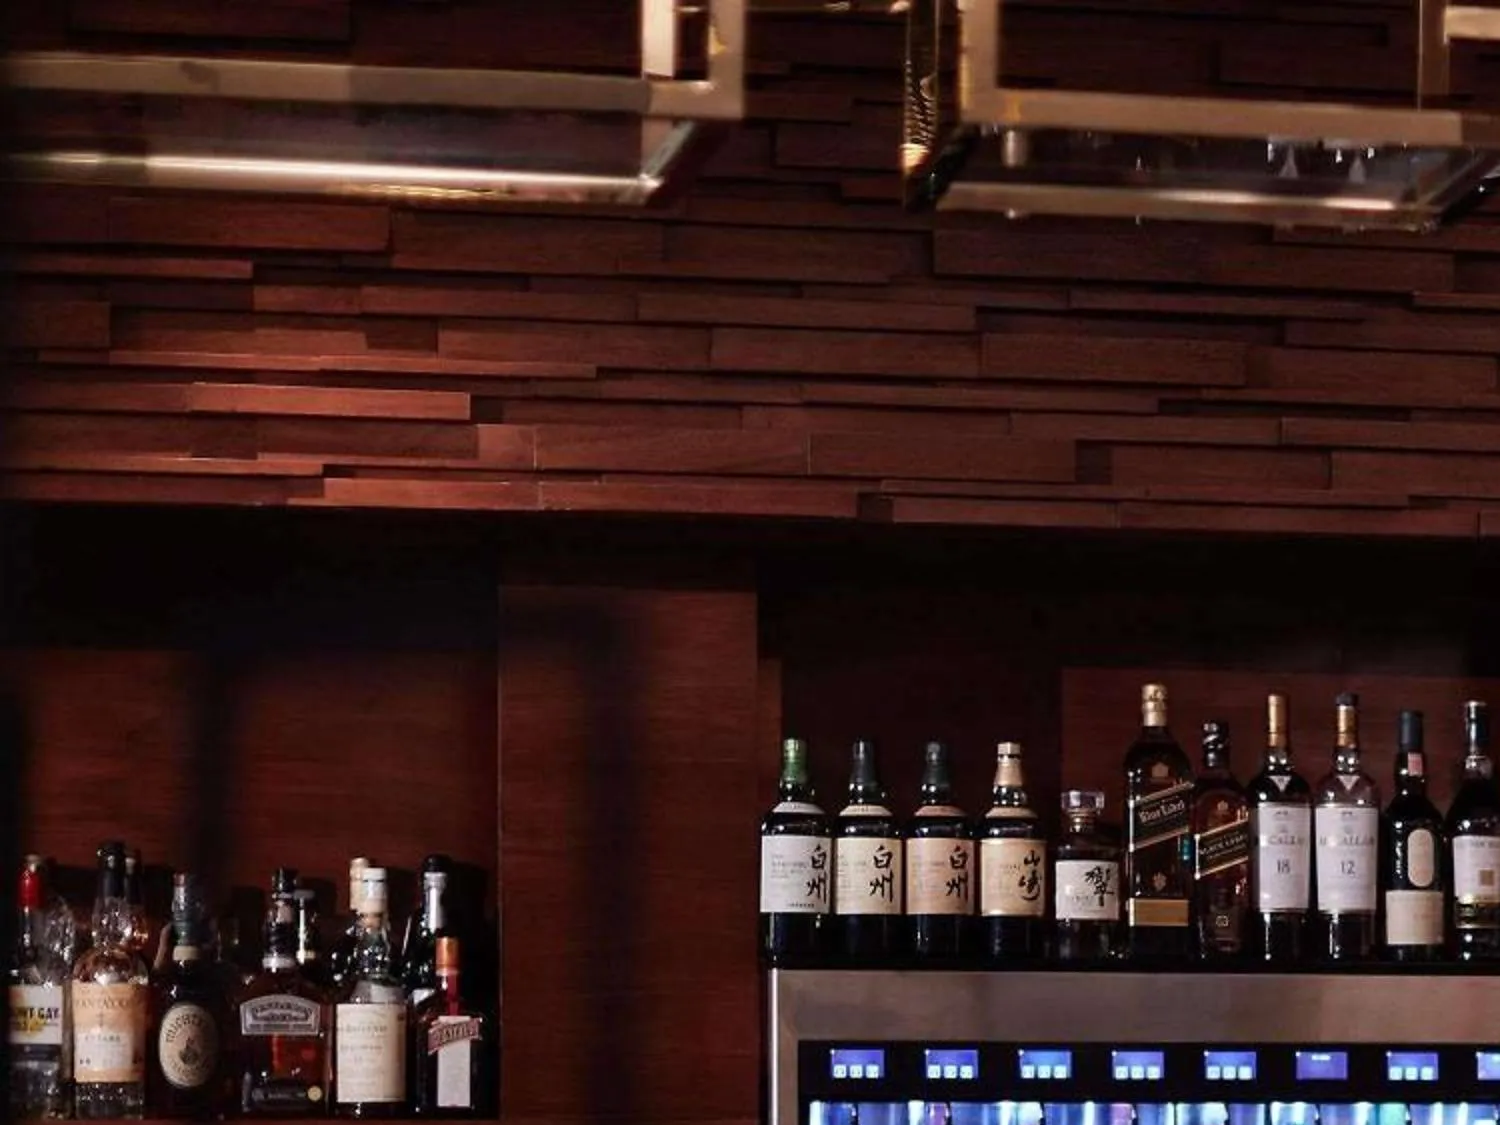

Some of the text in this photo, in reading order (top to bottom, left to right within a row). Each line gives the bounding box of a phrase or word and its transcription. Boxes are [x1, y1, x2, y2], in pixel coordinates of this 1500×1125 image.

[806, 844, 827, 904] 白州
[869, 845, 894, 903] 白州
[946, 845, 969, 904] 白州
[1276, 859, 1291, 874] 18
[1341, 860, 1356, 875] 12
[37, 1007, 60, 1019] GAY
